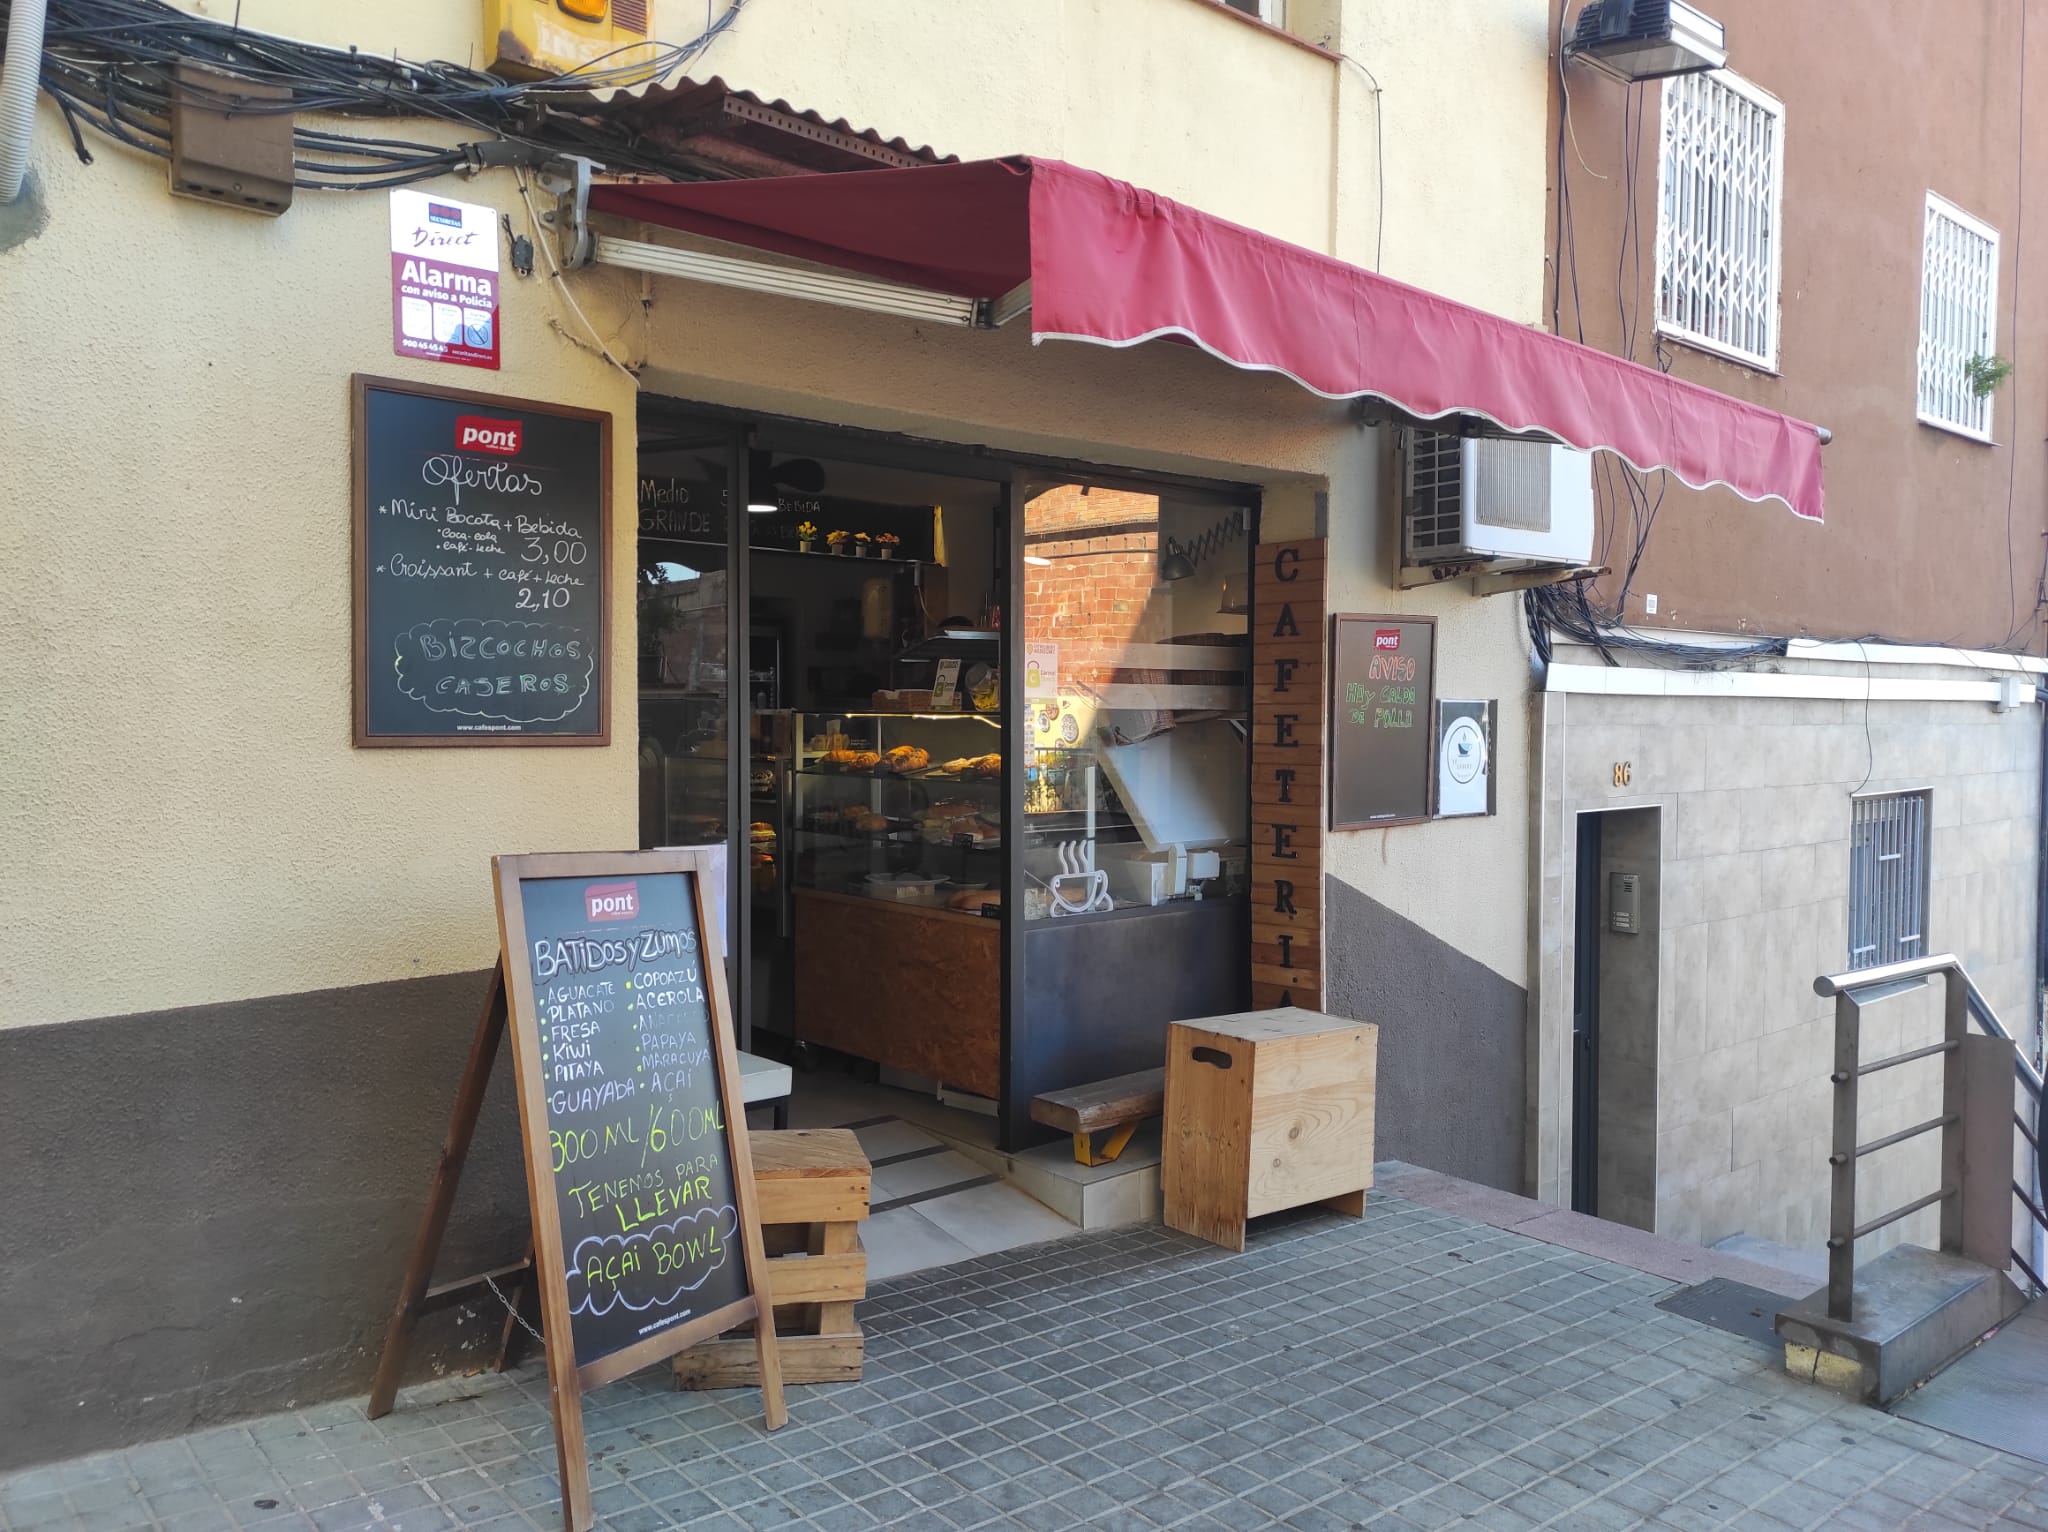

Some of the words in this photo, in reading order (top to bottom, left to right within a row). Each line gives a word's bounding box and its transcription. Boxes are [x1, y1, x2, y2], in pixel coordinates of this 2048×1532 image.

[411, 227, 480, 247] Direct
[401, 259, 493, 296] Alarma
[401, 285, 420, 295] con
[422, 288, 449, 299] aviso
[451, 293, 458, 302] a
[463, 427, 517, 447] pont
[422, 455, 543, 505] Ofertas
[391, 498, 439, 521] Mini
[446, 506, 501, 530] Bocata
[515, 514, 583, 539] Bebida
[638, 508, 711, 533] GRANDE
[520, 536, 588, 565] 3,00
[390, 553, 478, 580] Croissant
[515, 587, 571, 613] 2,10
[1376, 635, 1399, 648] pont
[1369, 654, 1416, 682] AVISO
[435, 673, 570, 697] CASEROS
[1612, 761, 1632, 787] 86
[591, 893, 634, 918] pont
[547, 981, 616, 1005] AGUACATE
[636, 986, 706, 1010] ACEROLA
[546, 999, 615, 1023] PLATANO
[551, 1021, 601, 1043] FRESA
[641, 1031, 697, 1051] PAPAYA
[555, 1060, 605, 1083] PITAYA
[548, 1129, 599, 1173] 300
[603, 1116, 640, 1155] ML
[568, 1169, 665, 1218] TENEMOS
[675, 1153, 719, 1181] PARA
[615, 1175, 713, 1232] LLEVAR
[652, 1226, 721, 1275] BOWL
